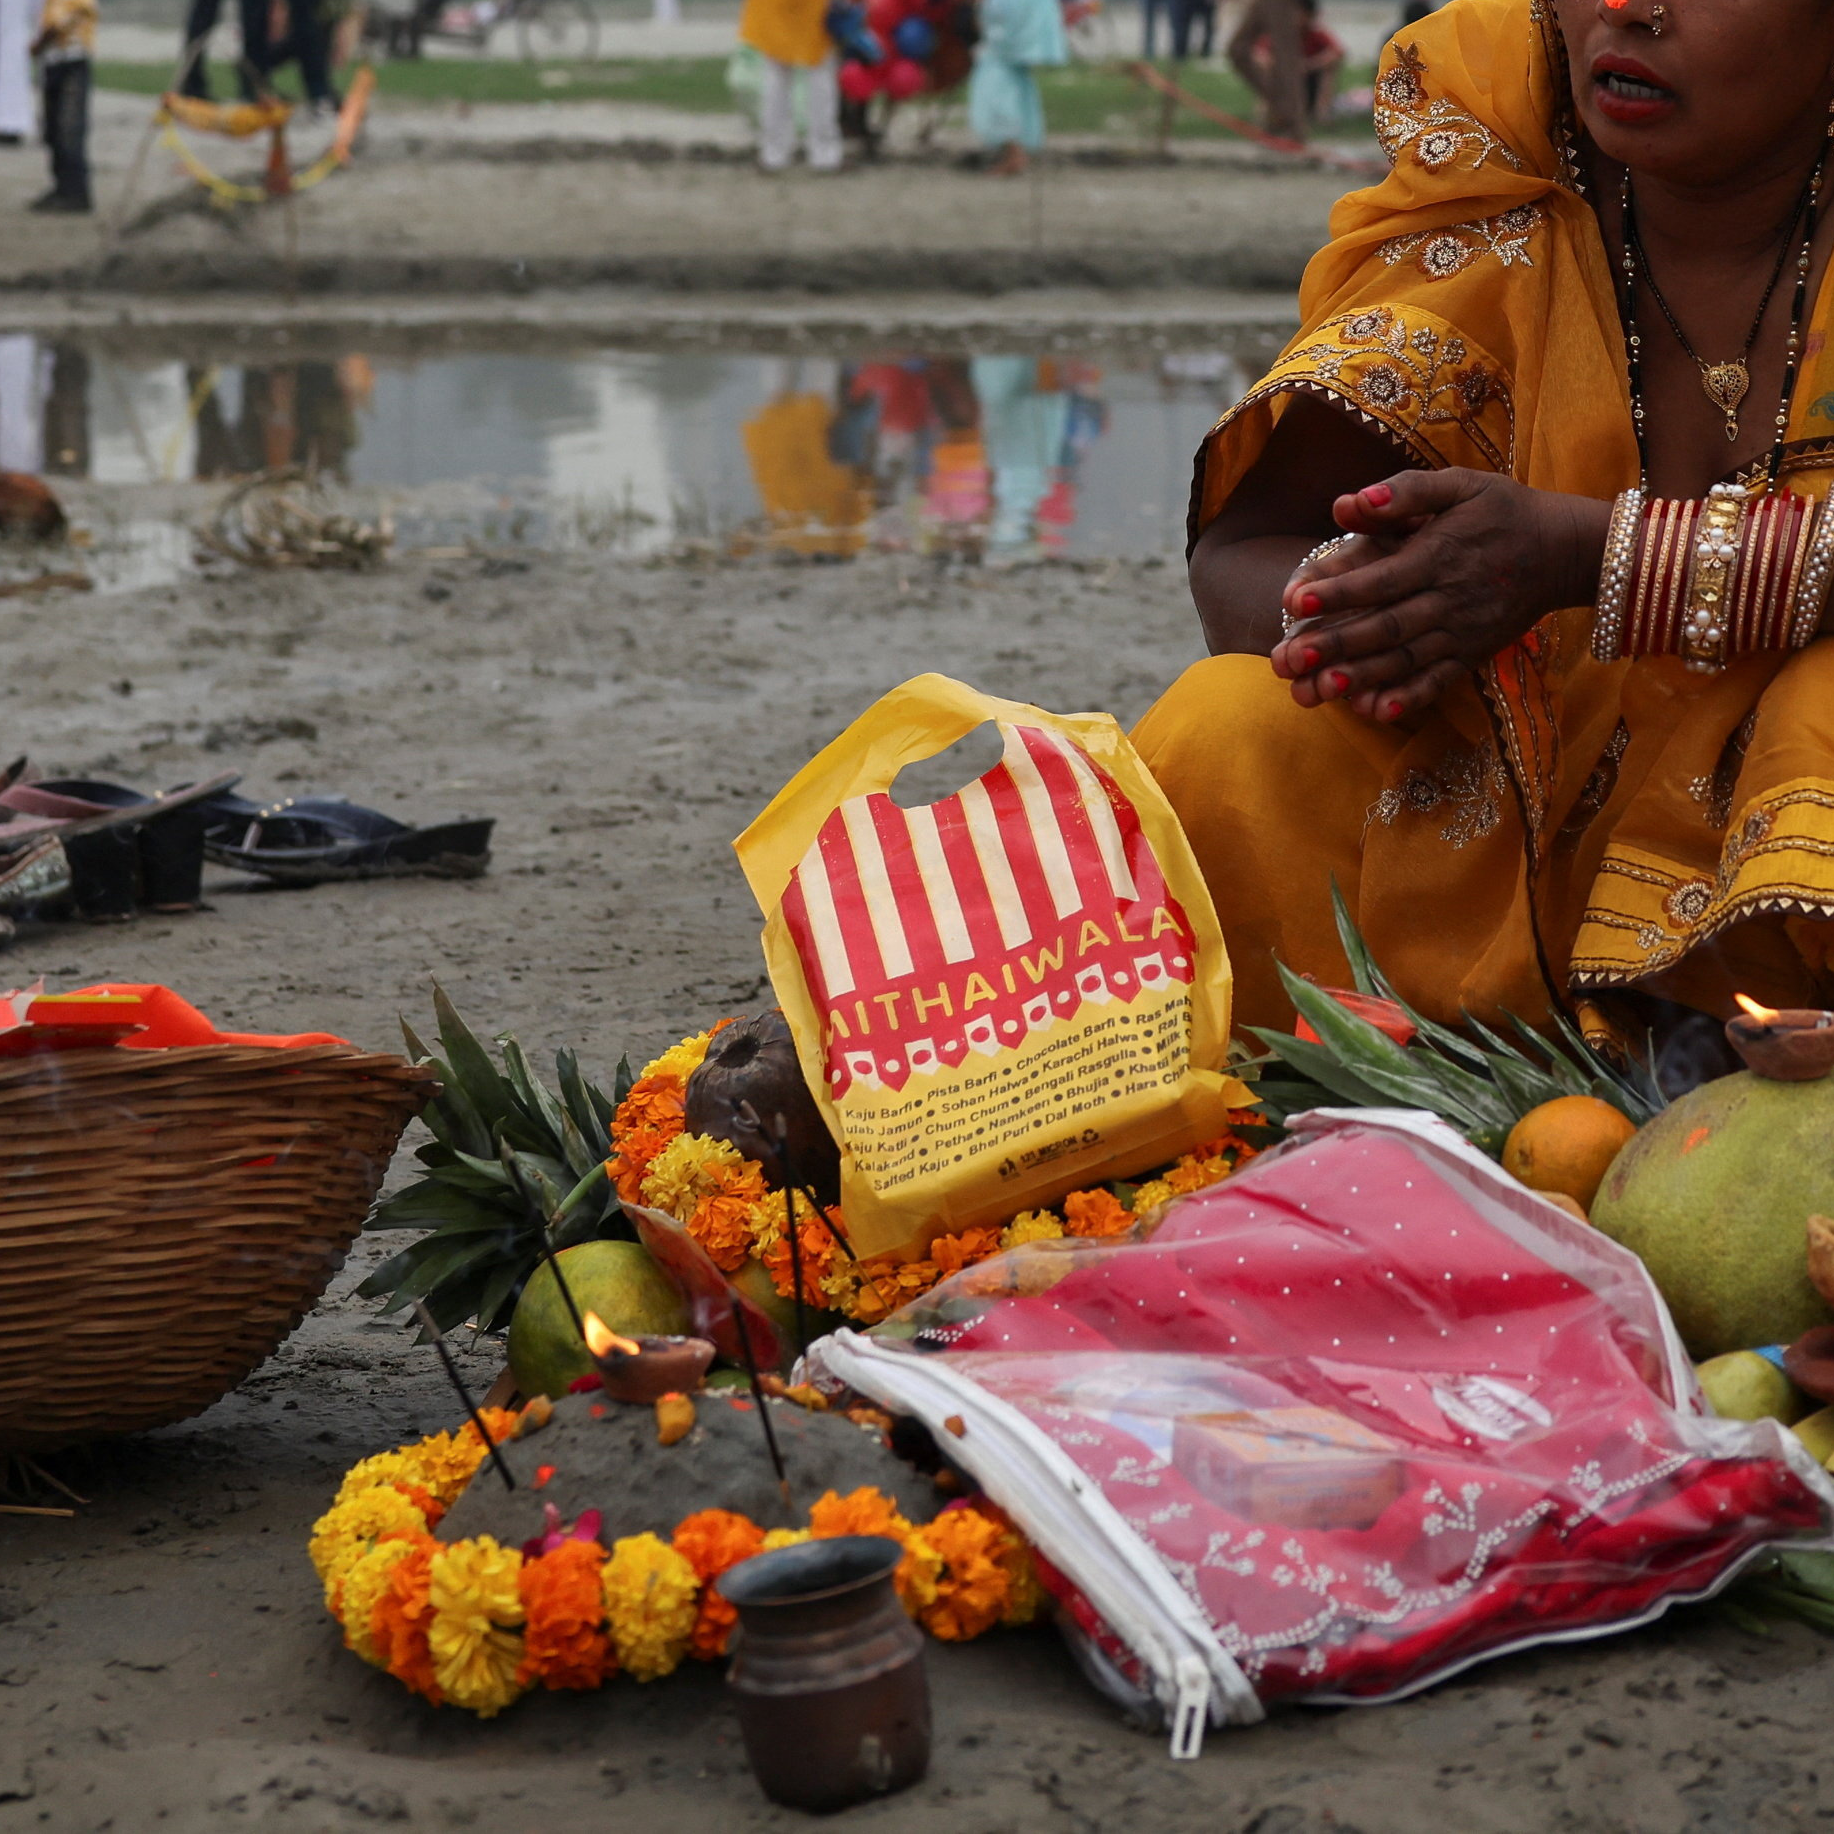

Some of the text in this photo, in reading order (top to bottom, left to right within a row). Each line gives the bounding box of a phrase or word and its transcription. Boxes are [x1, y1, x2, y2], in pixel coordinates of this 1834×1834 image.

[845, 1109, 875, 1122] Kaju
[881, 1102, 912, 1119] Barfi
[927, 1084, 960, 1101] Pista
[965, 1072, 997, 1090] Barfi
[1016, 1033, 1080, 1071] Chocolate
[1083, 1018, 1115, 1038] Barfi
[1136, 1010, 1161, 1025] Ras
[877, 1138, 907, 1152] Katli
[925, 1118, 966, 1135] Chum
[970, 1101, 1009, 1122] Chum
[1025, 1071, 1074, 1100] Bengali
[1078, 1048, 1137, 1079] Rasgulla
[1156, 1031, 1180, 1053] Milk
[878, 1116, 923, 1136] Jamun
[941, 1095, 985, 1113] Sohan
[989, 1077, 1029, 1097] Halwa
[1042, 1043, 1094, 1073] Karachi
[1097, 1033, 1139, 1051] Halwa
[1158, 1015, 1178, 1034] Raj
[855, 1149, 915, 1173] Kalakand
[935, 1132, 973, 1150] Petha
[989, 1098, 1050, 1131] Namkeen
[1067, 1077, 1110, 1099] Bhujia
[874, 1168, 915, 1191] Salted
[919, 1158, 949, 1175] Kaju
[969, 1137, 999, 1156] Bhel
[1003, 1122, 1030, 1142] Puri
[1045, 1108, 1067, 1125] Dal
[1072, 1095, 1106, 1115] Moth
[1125, 1078, 1157, 1095] Hara
